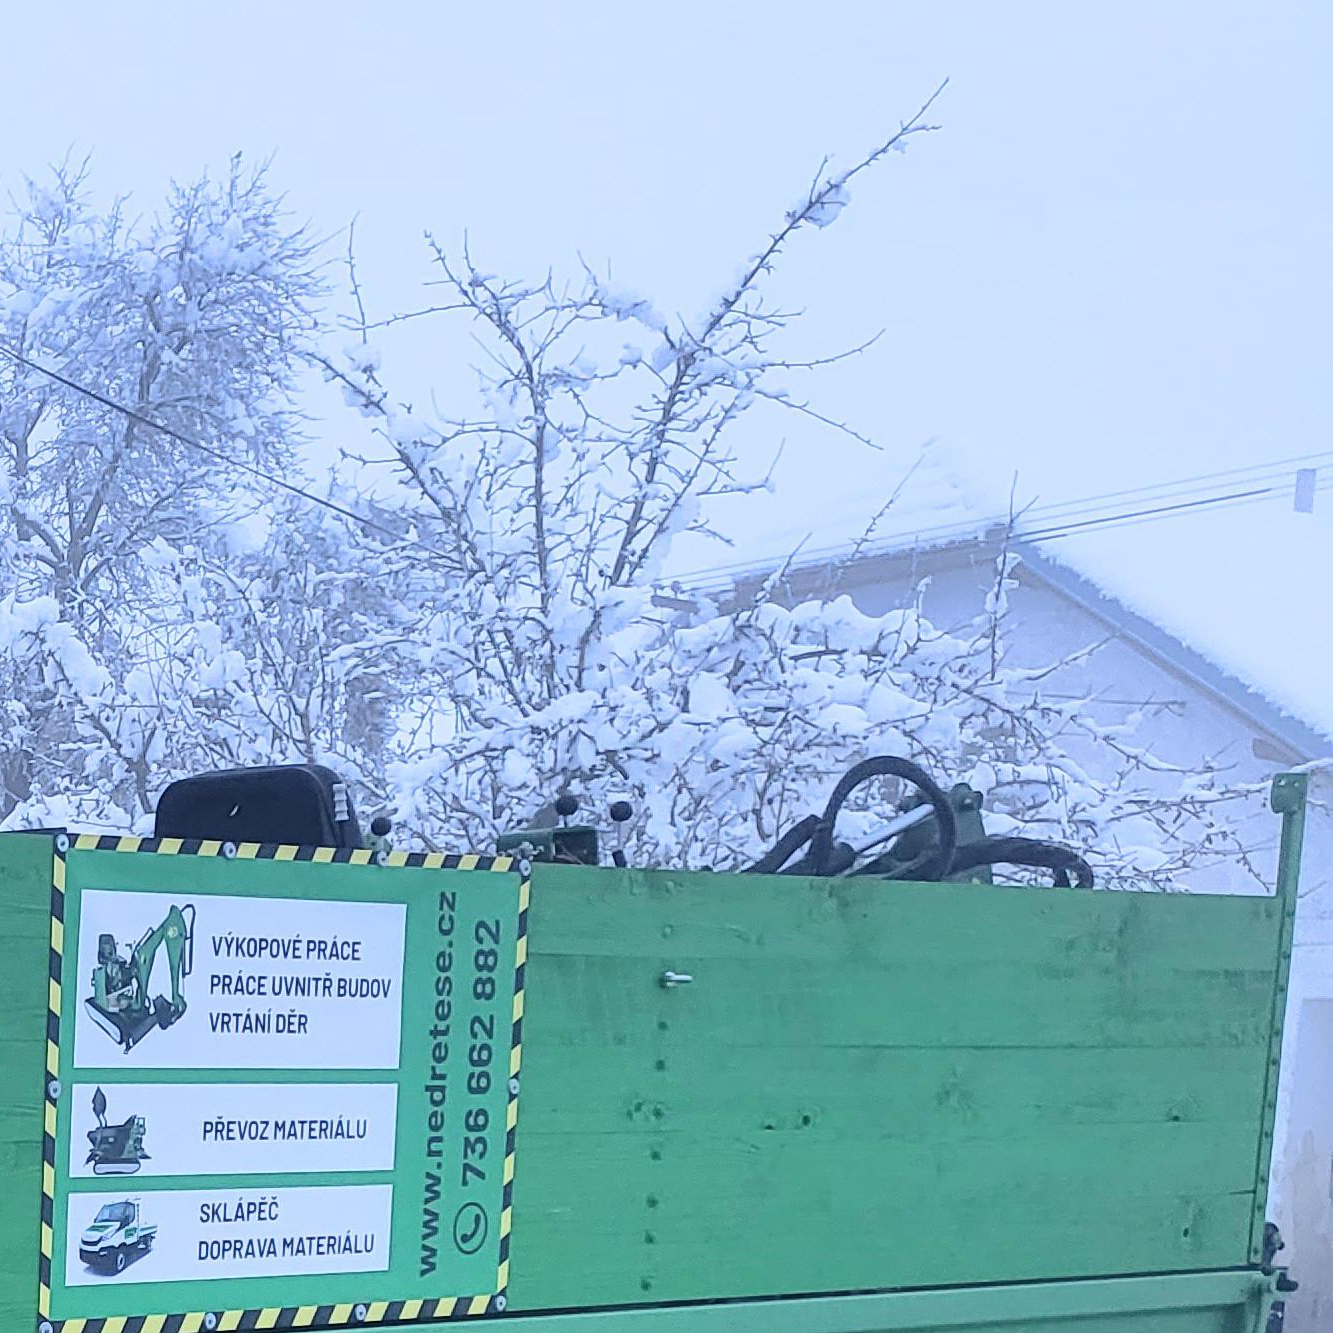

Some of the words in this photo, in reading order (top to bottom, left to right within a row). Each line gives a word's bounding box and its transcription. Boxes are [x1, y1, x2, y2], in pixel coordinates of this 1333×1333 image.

[211, 931, 303, 960] VÝKOPOVÉ
[306, 935, 362, 961] PRÁCE
[472, 918, 501, 1001] 882
[209, 969, 268, 996] PRÁCE
[271, 971, 333, 998] UVNITŘ
[336, 977, 392, 999] BUDOV
[209, 1007, 273, 1035] VRTÁNÍ
[275, 1008, 309, 1035] DĚR
[466, 1013, 495, 1096] 662
[419, 891, 457, 1278] www.nedretese.cz
[202, 1115, 270, 1142] PŘEVOZ
[273, 1114, 368, 1141] MATERIÁLU
[461, 1107, 490, 1187] 736
[199, 1195, 280, 1224] SKLÁPĚČ
[197, 1237, 278, 1261] DOPRAVA
[281, 1229, 375, 1258] MATERIÁLU
